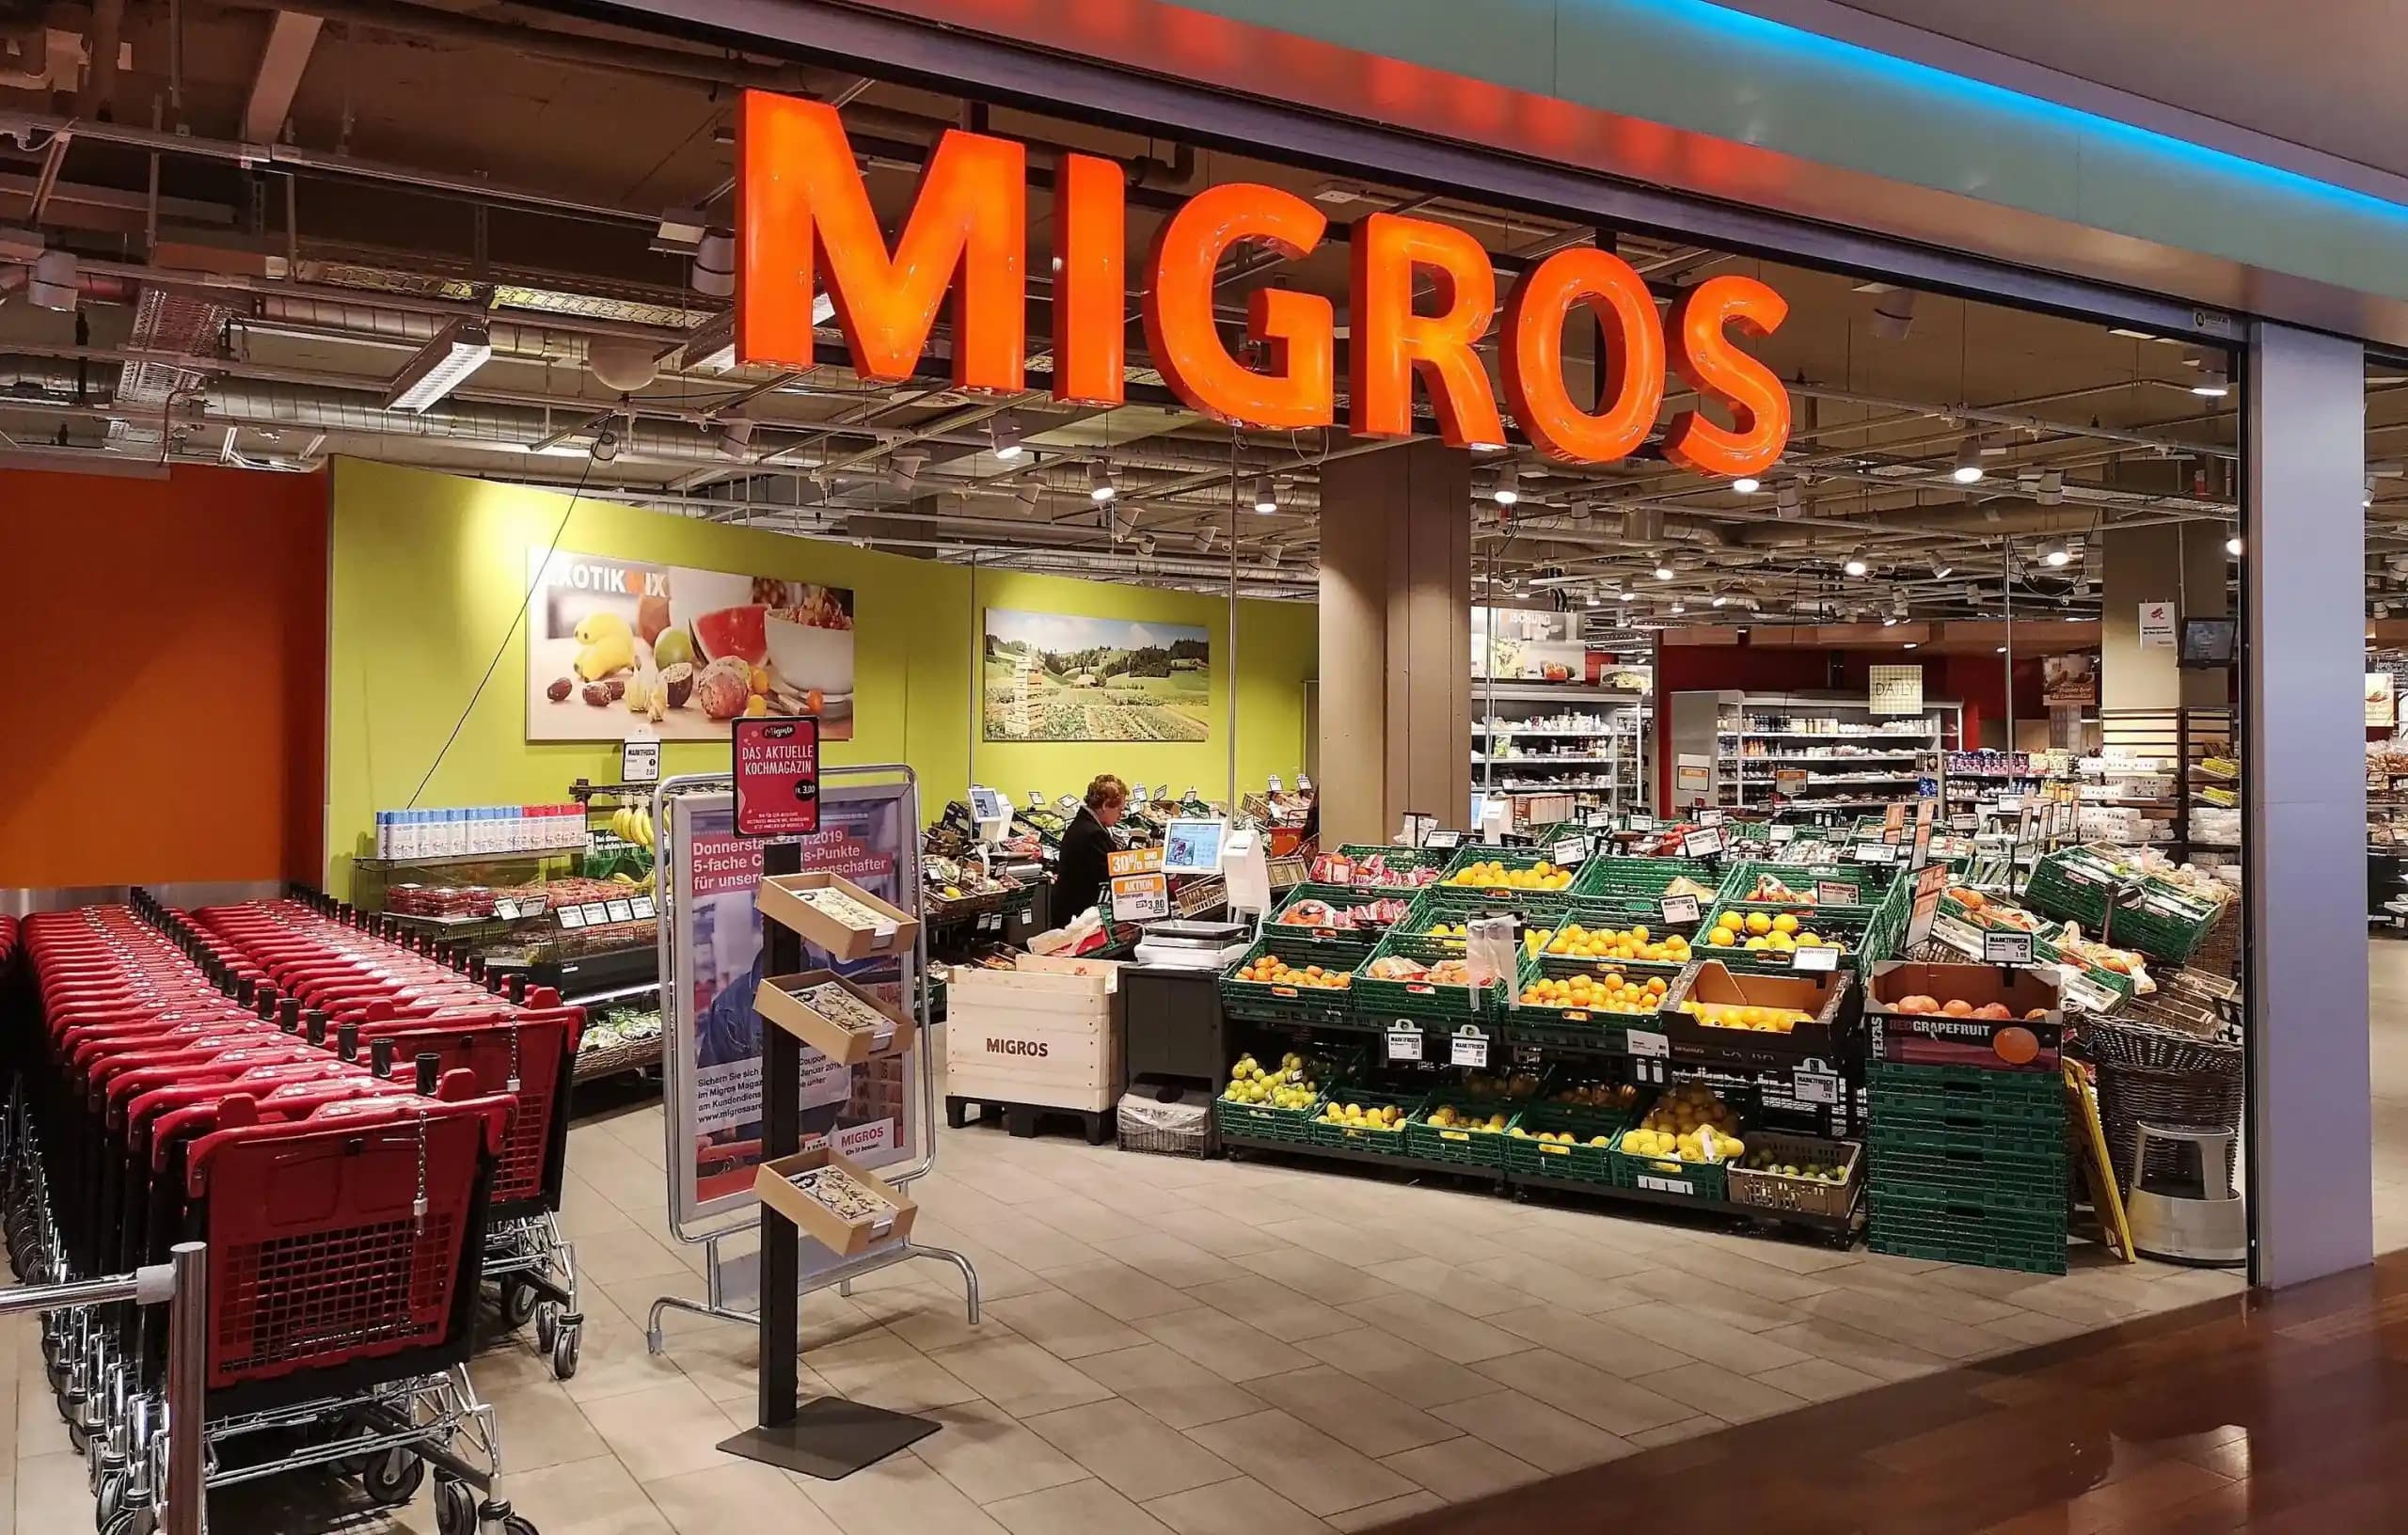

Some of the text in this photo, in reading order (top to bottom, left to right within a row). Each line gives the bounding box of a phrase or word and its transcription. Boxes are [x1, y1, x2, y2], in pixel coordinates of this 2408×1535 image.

[735, 88, 1791, 478] MIGROS
[1876, 682, 1915, 696] DAILY
[742, 745, 814, 760] DAS AKTUELLE
[745, 760, 812, 776] KOCHMAGAZIN
[693, 856, 747, 873] 5-fache
[1112, 854, 1142, 873] 30%
[694, 875, 716, 890] für
[1871, 1016, 1884, 1059] TEXAS
[1912, 1020, 1990, 1037] GRAPEFRUIT
[986, 1037, 1048, 1057] MIGROS
[698, 1075, 728, 1087] Sichern
[729, 1072, 741, 1081] Sie
[742, 1068, 759, 1078] sich
[709, 1084, 736, 1097] Migros
[698, 1103, 710, 1112] am
[712, 1091, 761, 1108] Kundendiens
[841, 1127, 884, 1147] MIGROS
